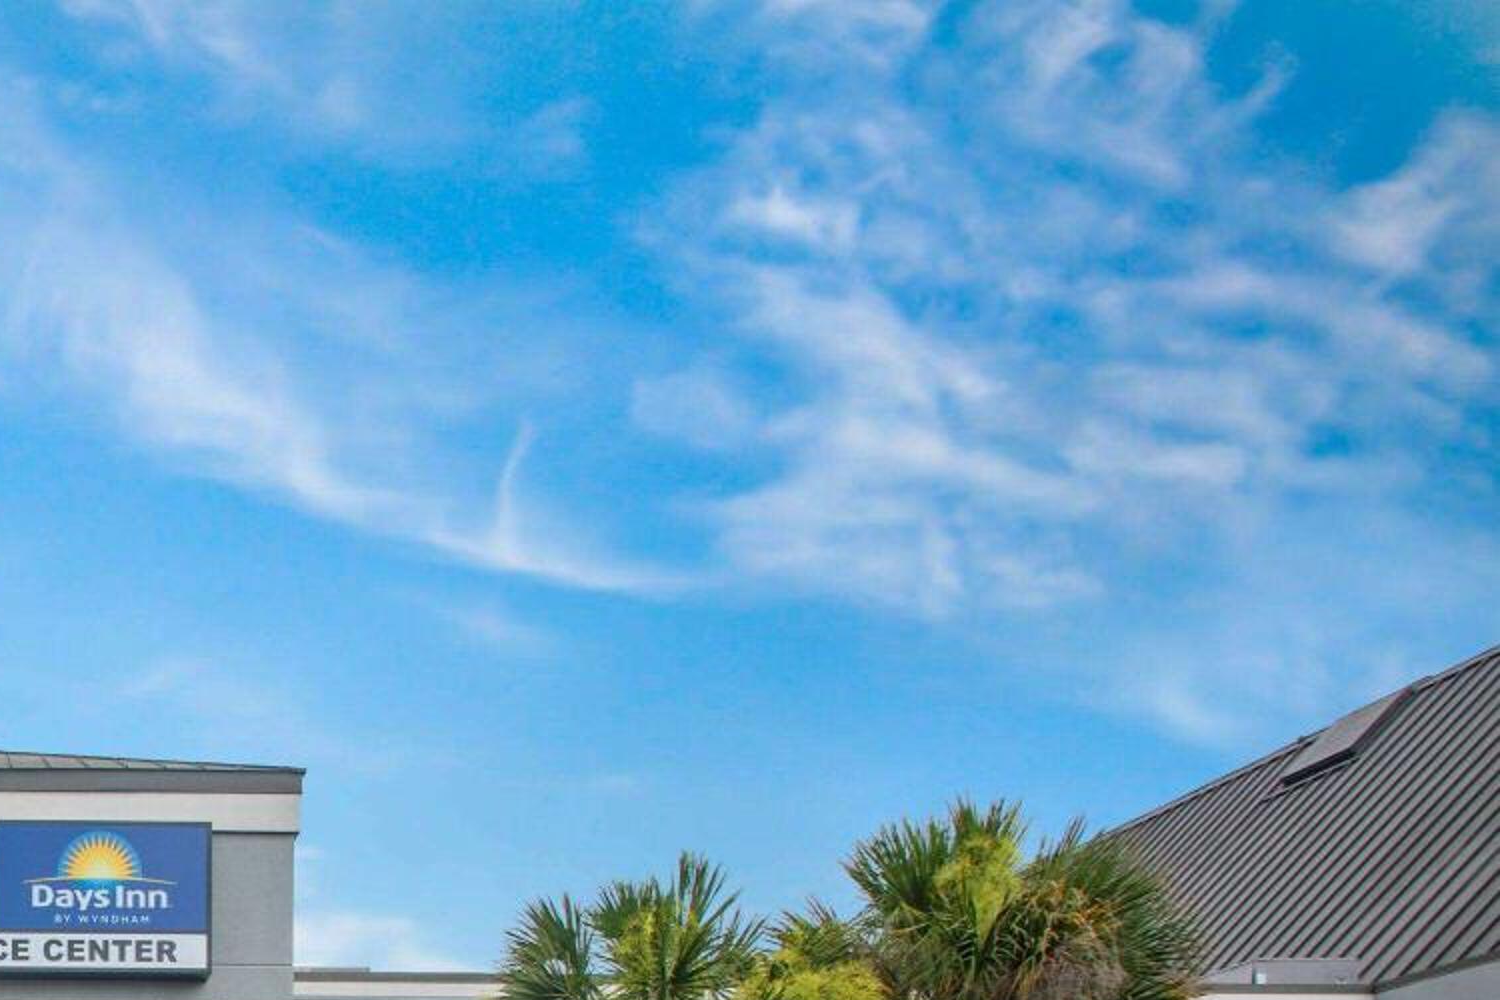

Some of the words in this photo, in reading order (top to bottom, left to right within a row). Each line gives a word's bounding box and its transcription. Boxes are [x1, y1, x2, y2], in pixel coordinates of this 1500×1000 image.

[31, 884, 111, 911] Days
[115, 884, 169, 909] Inn
[53, 914, 72, 924] BY
[77, 914, 150, 924] WYNDHAM
[43, 939, 178, 963] CENTER
